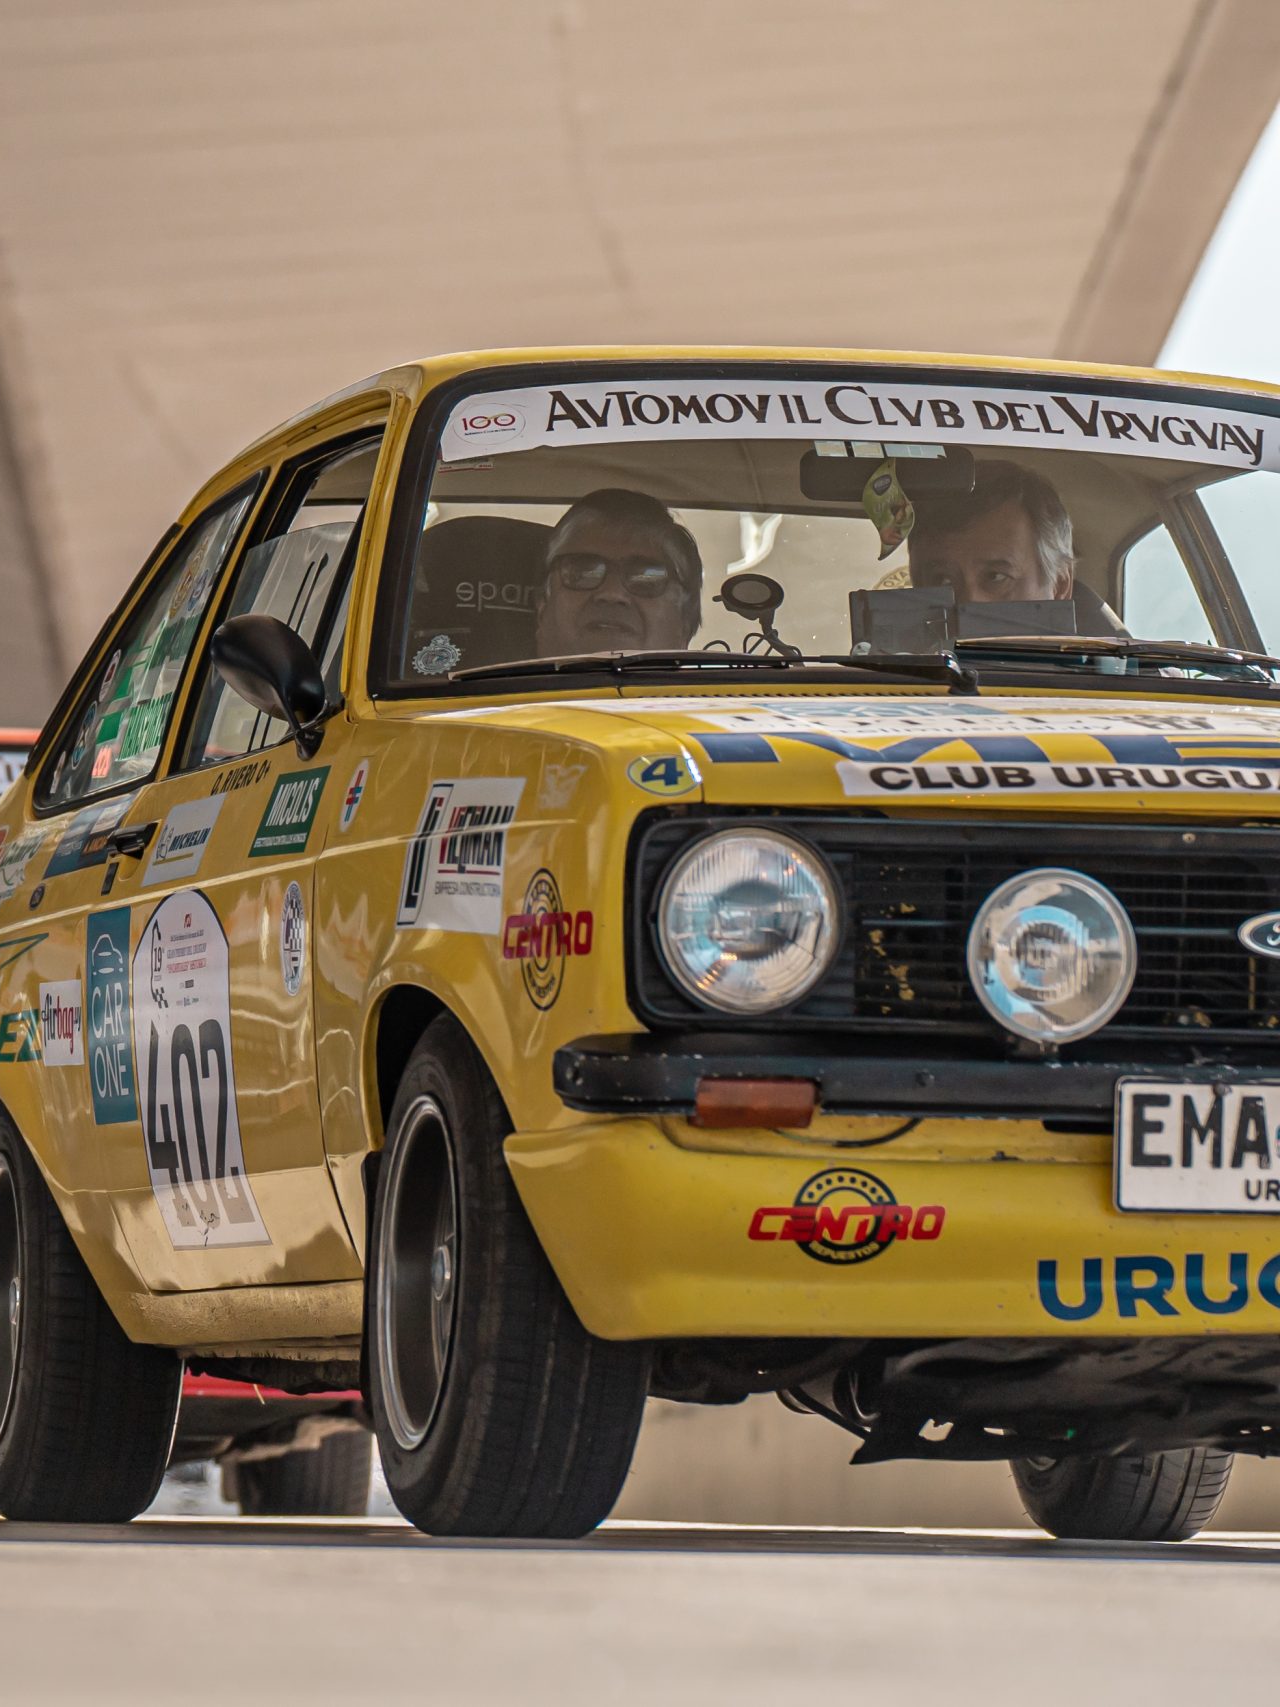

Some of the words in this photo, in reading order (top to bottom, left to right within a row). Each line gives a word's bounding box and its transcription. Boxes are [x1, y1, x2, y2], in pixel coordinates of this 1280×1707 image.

[972, 400, 1065, 435] DEL
[641, 757, 684, 787] 4
[869, 766, 1036, 790] CLUB
[1050, 766, 1280, 790] URUGU
[168, 827, 211, 852] MICHELIN
[502, 910, 594, 960] CENTRO
[91, 982, 124, 1039] CAR
[94, 1043, 130, 1099] ONE
[147, 1018, 256, 1229] 402
[1130, 1093, 1271, 1169] EMA
[747, 1205, 946, 1241] CENTRO
